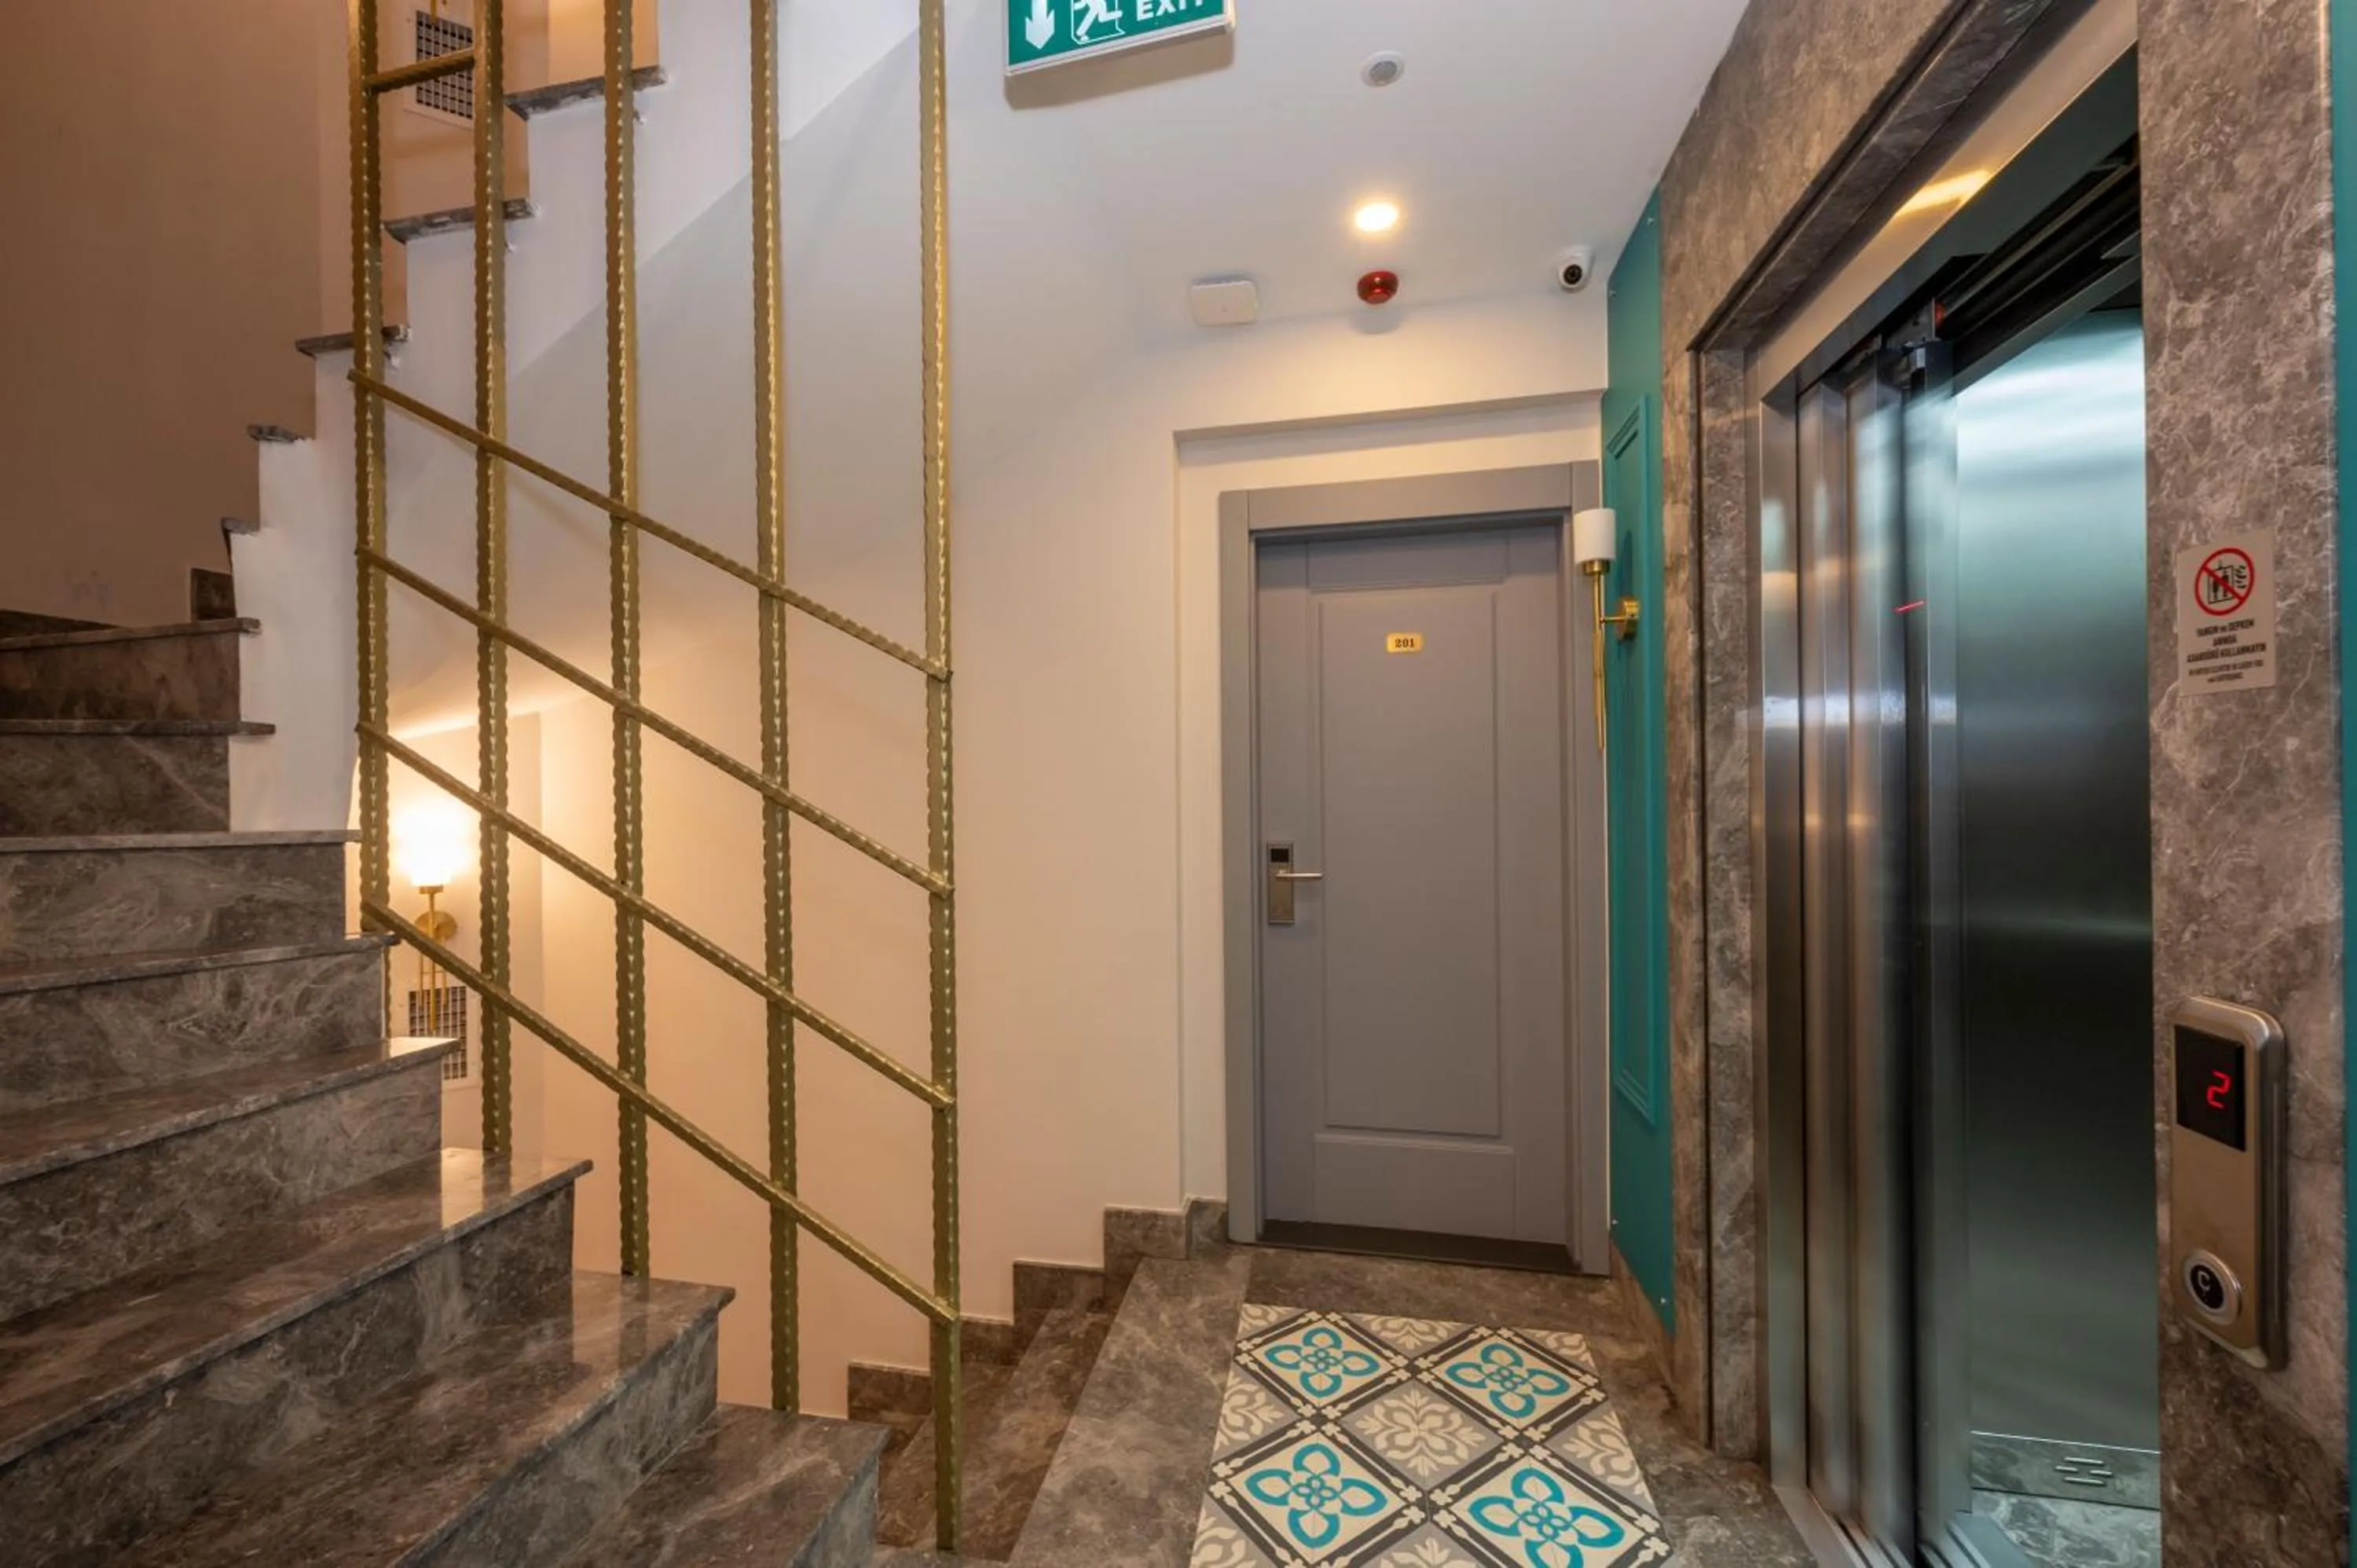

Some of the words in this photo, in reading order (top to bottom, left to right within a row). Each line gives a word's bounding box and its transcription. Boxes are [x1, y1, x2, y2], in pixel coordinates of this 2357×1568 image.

[1136, 0, 1203, 21] EX
[1395, 637, 1414, 648] 201
[2207, 1070, 2231, 1108] 2
